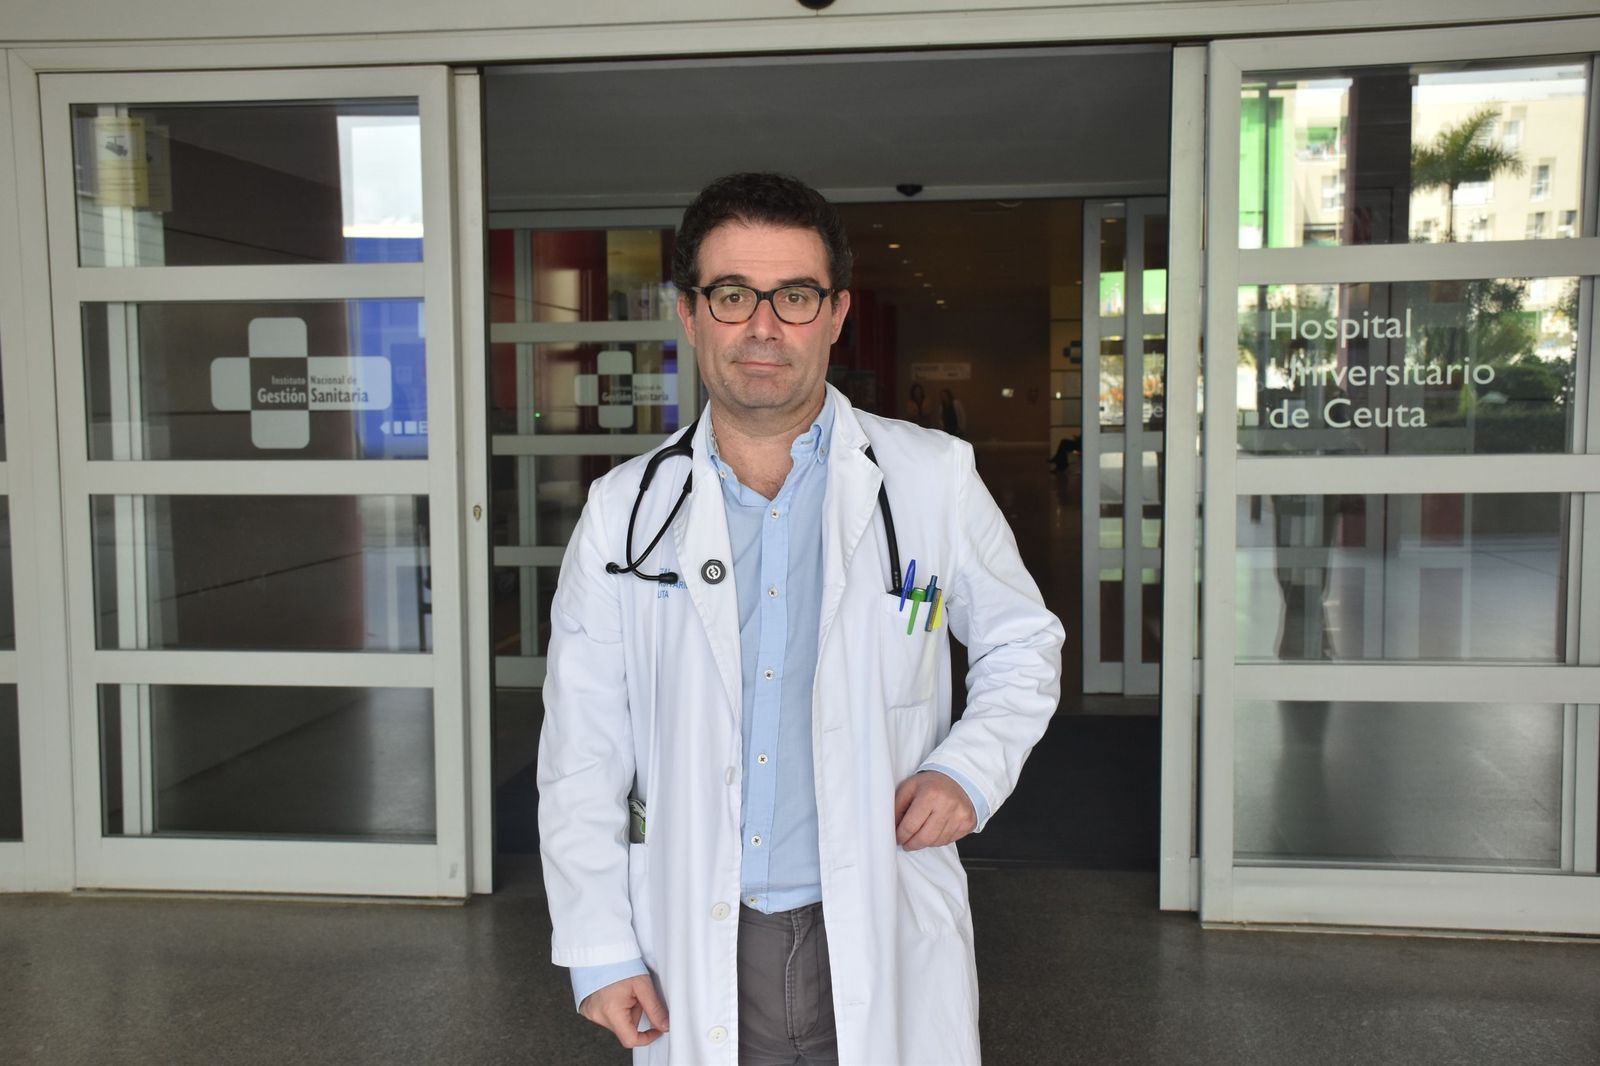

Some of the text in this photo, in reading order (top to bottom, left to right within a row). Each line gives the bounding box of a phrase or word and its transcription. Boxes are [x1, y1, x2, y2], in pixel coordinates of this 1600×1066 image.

[1270, 307, 1412, 348] Hospital
[271, 375, 357, 385] Instituto Nacional de
[1269, 357, 1496, 386] Universitario
[257, 387, 369, 403] Gestión Sanitaria
[1269, 398, 1428, 429] de Ceuta
